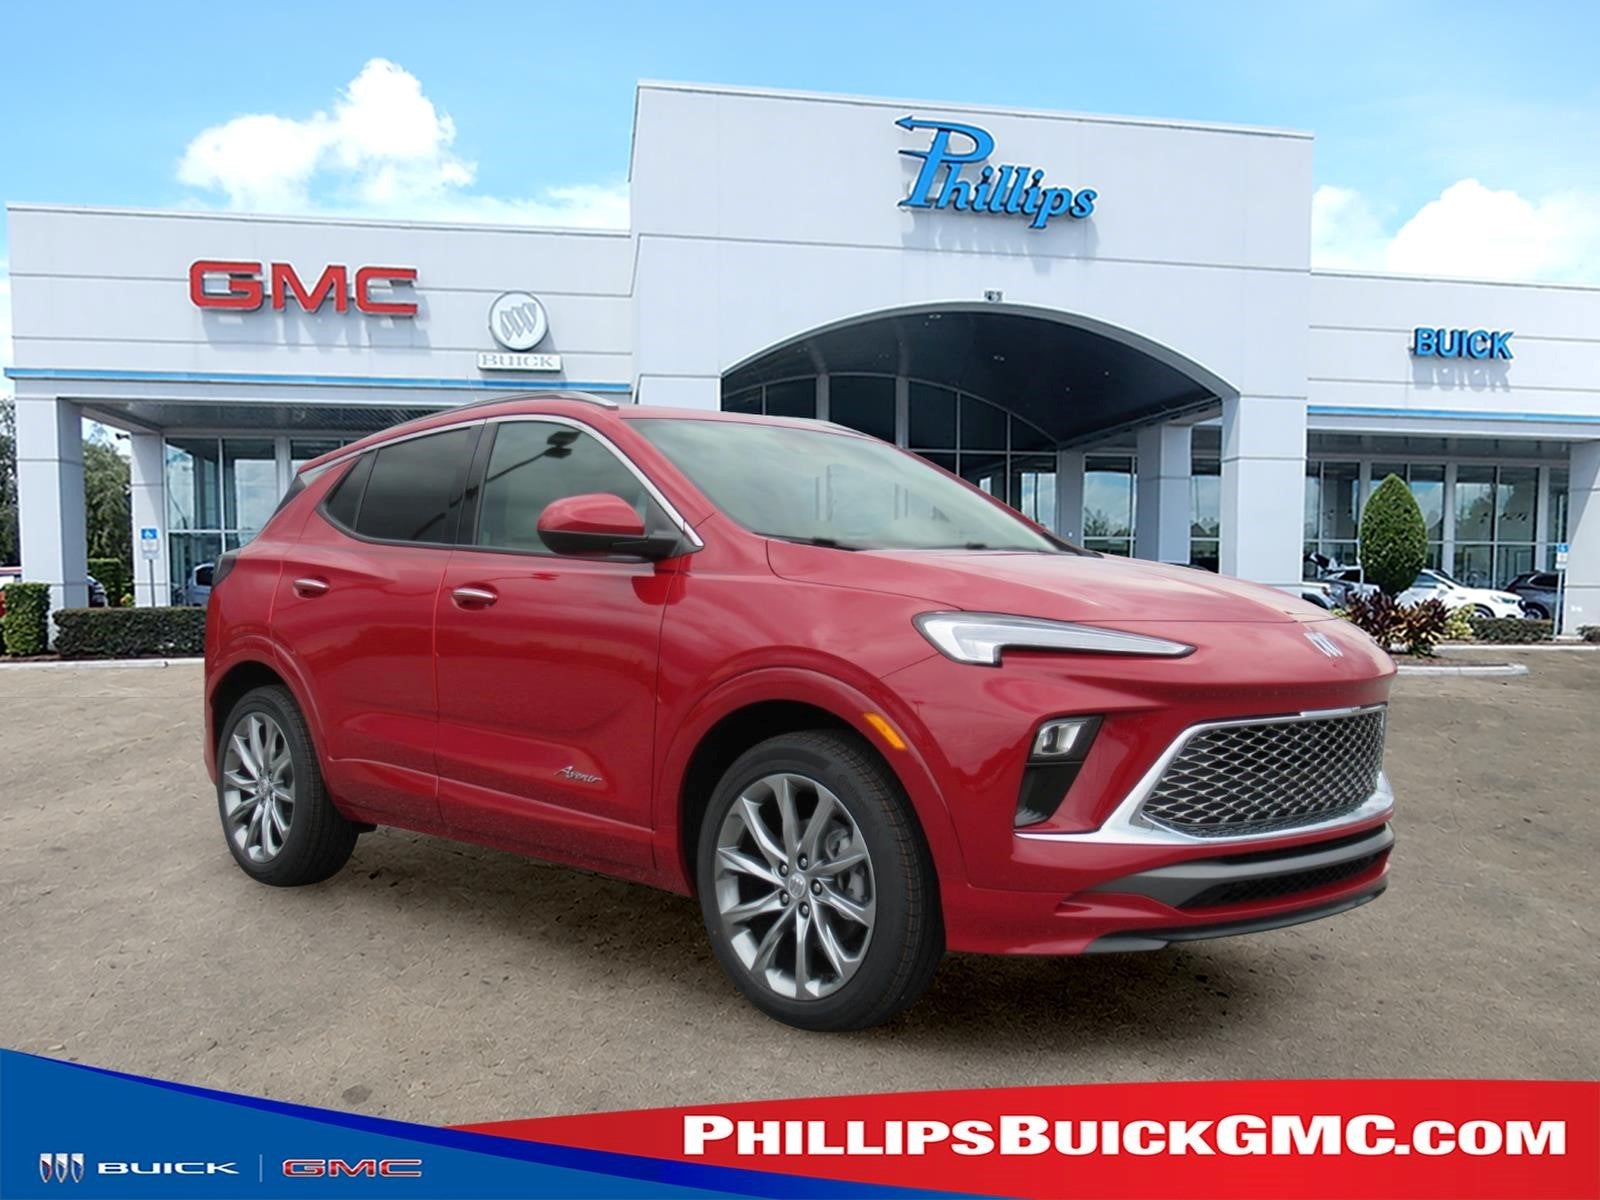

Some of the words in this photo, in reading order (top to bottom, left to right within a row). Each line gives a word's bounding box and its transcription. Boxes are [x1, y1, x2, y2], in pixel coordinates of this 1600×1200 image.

[895, 115, 1097, 229] Phillips
[189, 260, 418, 315] GMC
[481, 353, 556, 368] BUICK
[1414, 327, 1513, 361] BUICK
